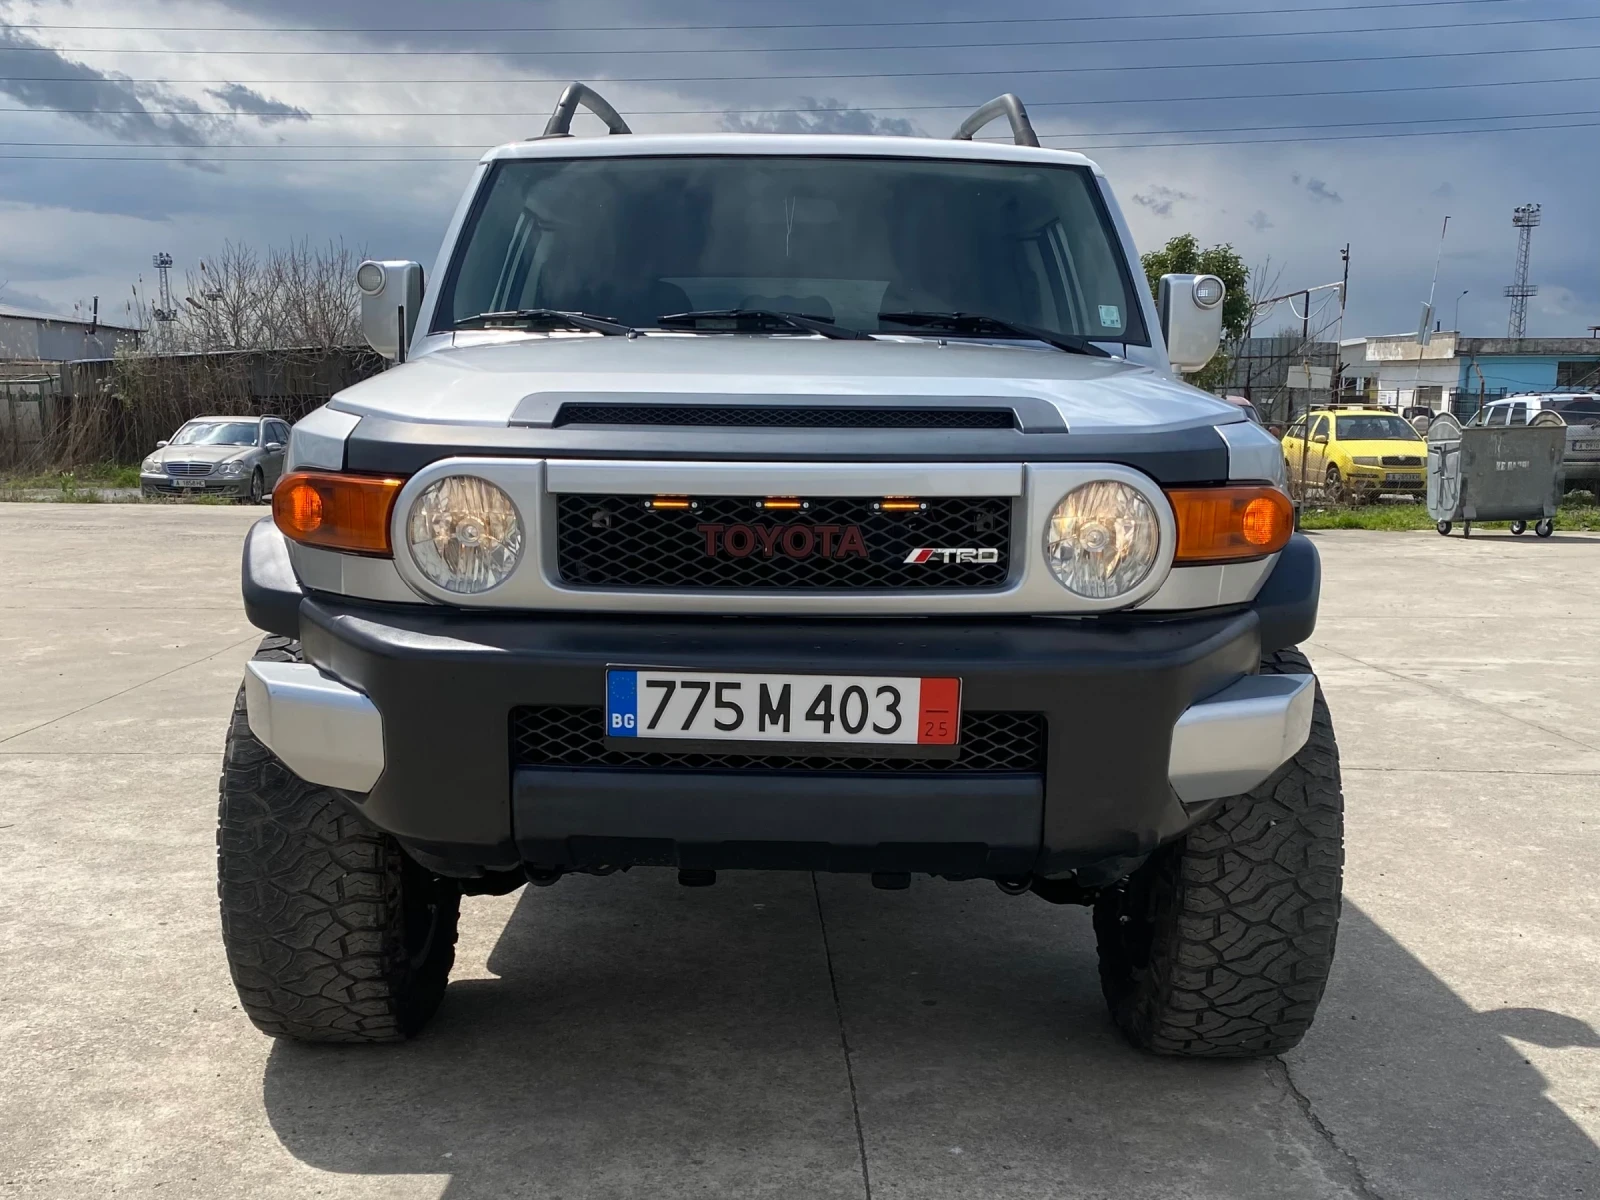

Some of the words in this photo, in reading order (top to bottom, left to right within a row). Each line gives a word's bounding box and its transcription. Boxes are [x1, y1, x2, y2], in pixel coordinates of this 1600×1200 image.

[697, 524, 869, 558] TOYOTA
[934, 548, 999, 564] TRD
[646, 680, 744, 732] 775
[758, 683, 792, 733] M
[805, 684, 903, 735] 403
[612, 713, 635, 728] BG
[925, 721, 948, 737] 25
